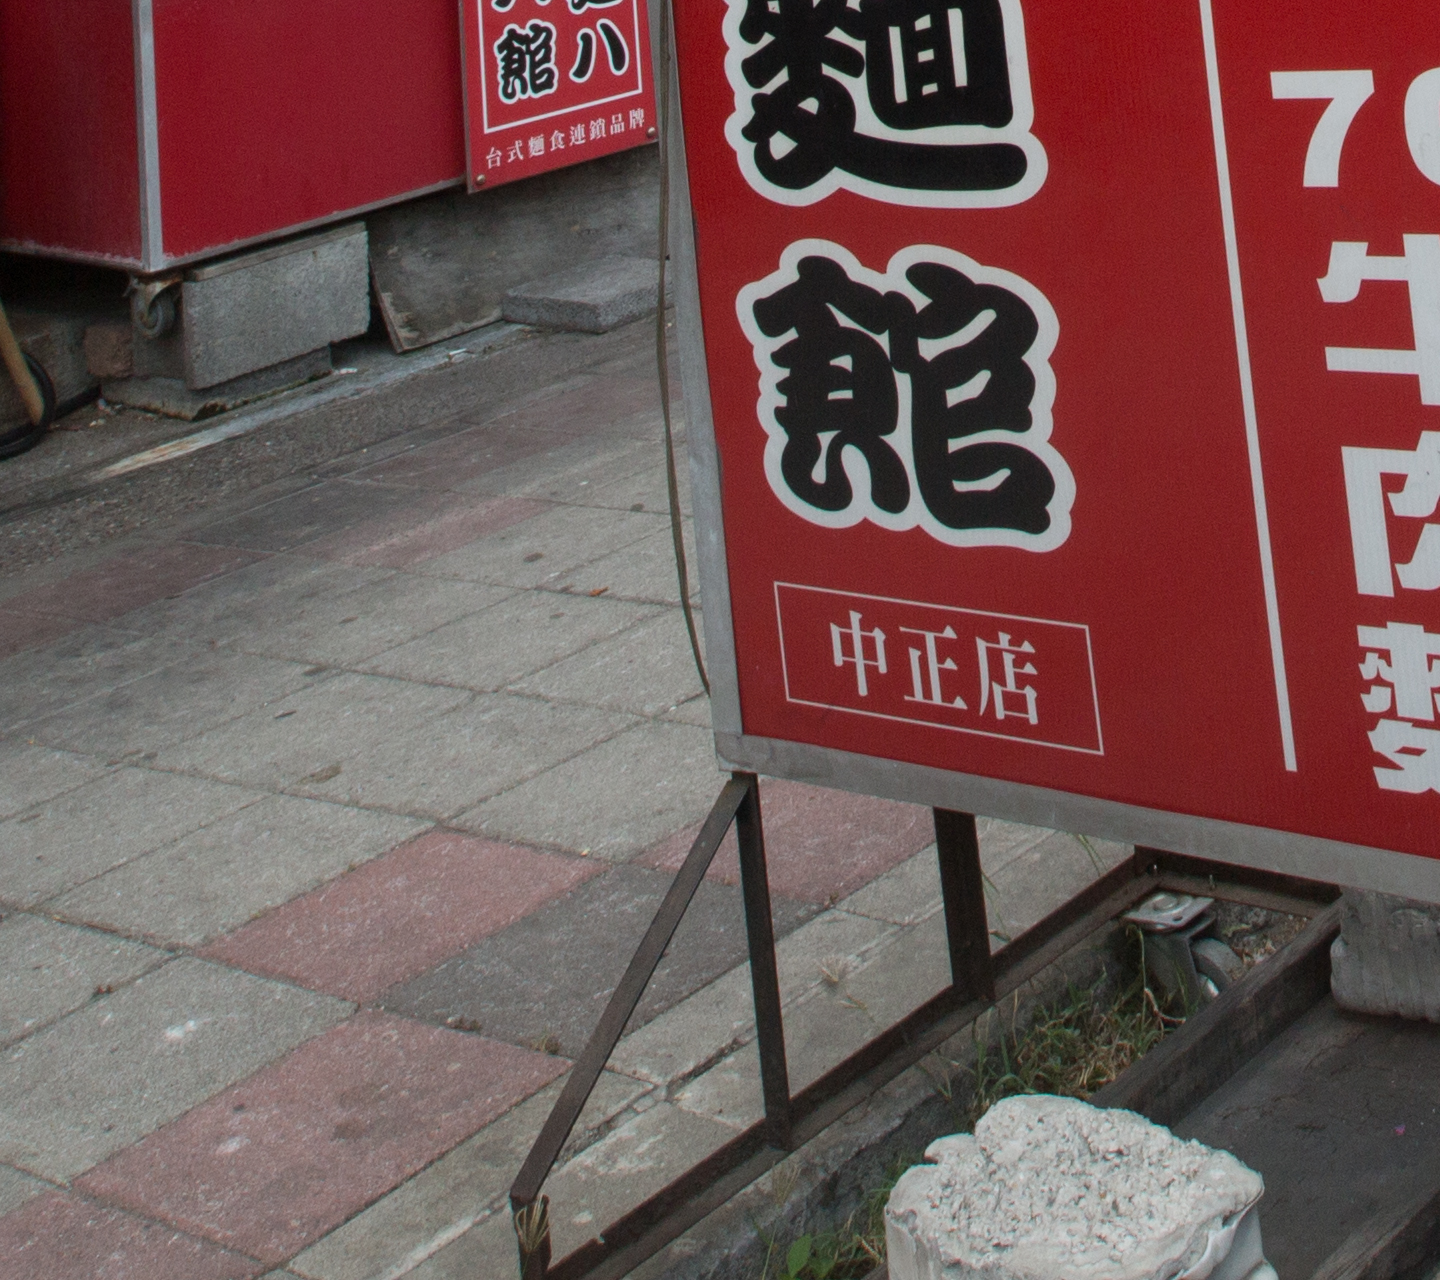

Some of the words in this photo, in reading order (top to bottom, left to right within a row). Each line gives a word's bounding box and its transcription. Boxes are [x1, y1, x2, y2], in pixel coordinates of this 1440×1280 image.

[485, 107, 646, 170] 台式麵食連鎖品牌
[829, 606, 1041, 728] 中正店
